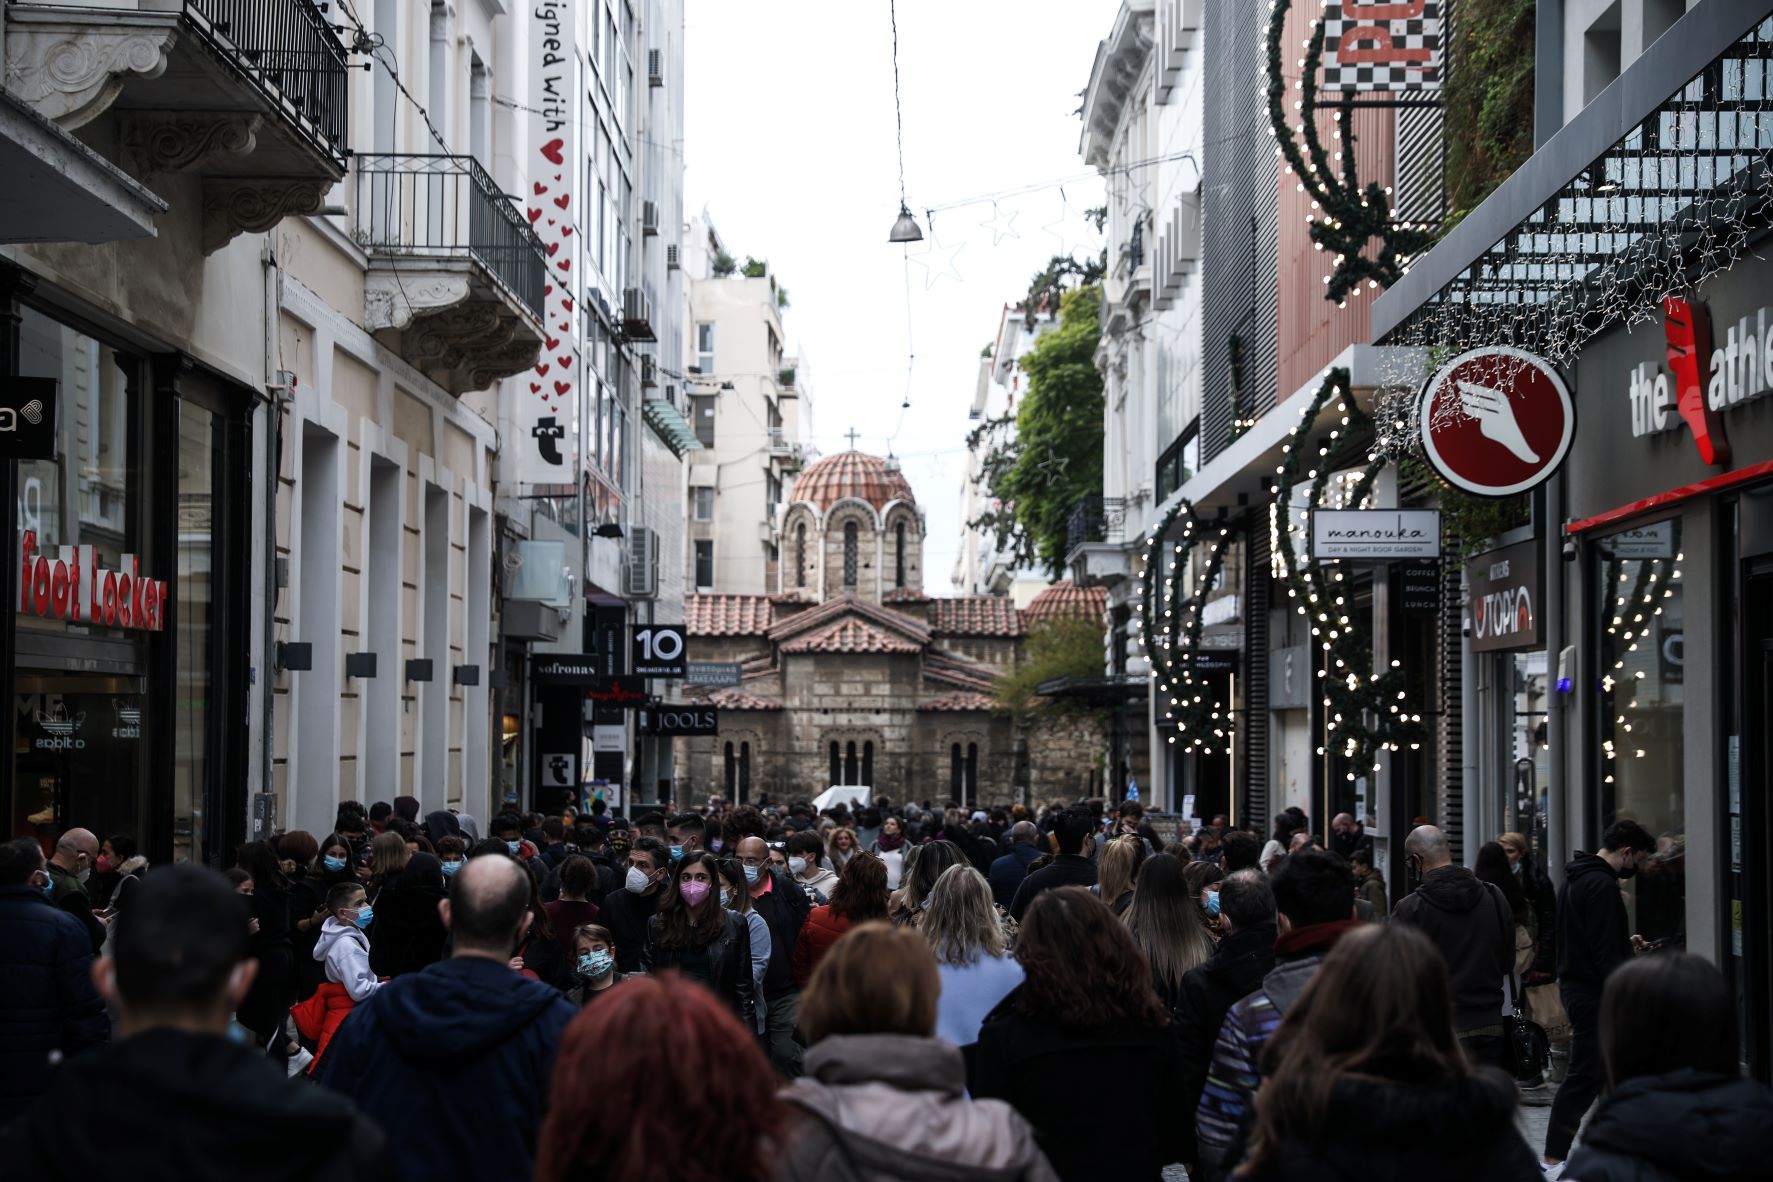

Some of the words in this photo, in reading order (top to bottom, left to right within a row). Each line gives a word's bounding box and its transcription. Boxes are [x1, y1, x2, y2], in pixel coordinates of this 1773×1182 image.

[543, 76, 567, 132] with
[1629, 361, 1669, 438] the
[1328, 513, 1427, 541] manouka
[1327, 546, 1342, 554] DAY
[1350, 546, 1372, 554] NIGHT
[1373, 546, 1392, 554] ROOF
[1394, 546, 1424, 554] GARDEN
[1405, 568, 1436, 577] COFFEE
[1405, 585, 1436, 593] BRUNCH
[1404, 601, 1436, 609] LUNCH
[635, 628, 683, 662] 10
[537, 662, 596, 676] sofronas
[658, 711, 716, 731] JOOLS
